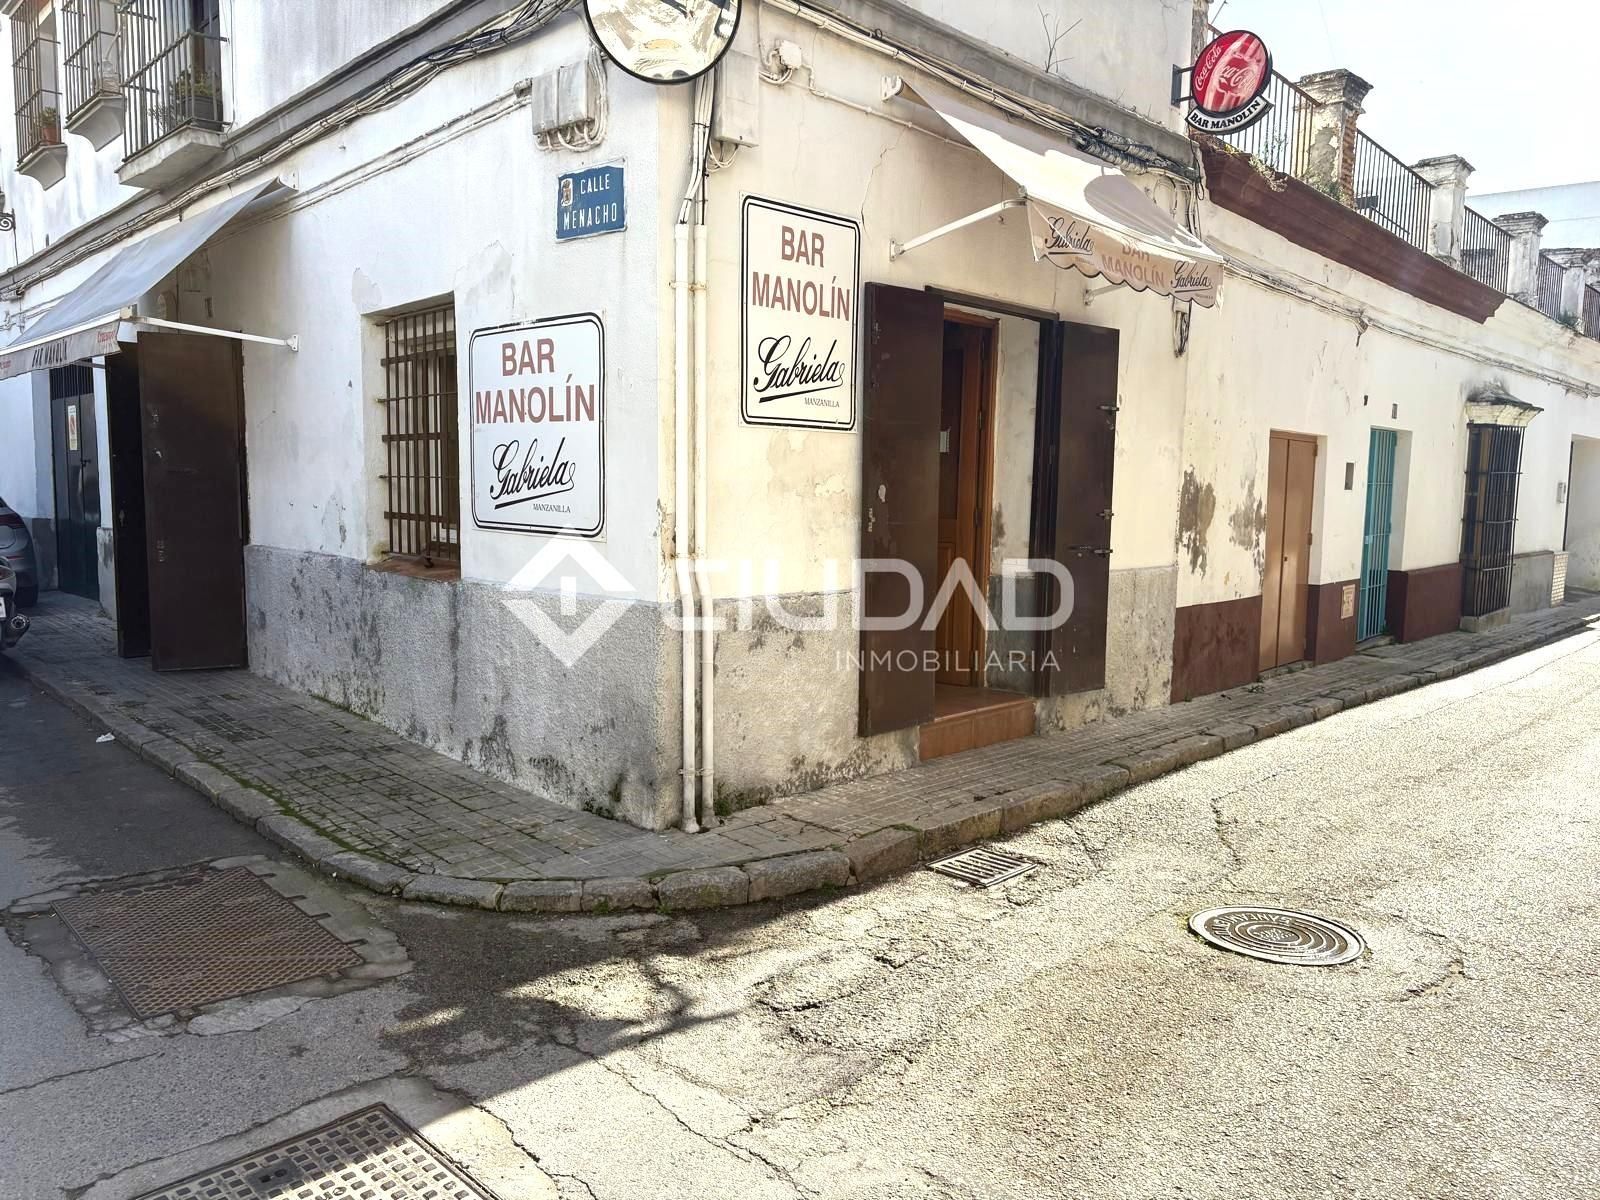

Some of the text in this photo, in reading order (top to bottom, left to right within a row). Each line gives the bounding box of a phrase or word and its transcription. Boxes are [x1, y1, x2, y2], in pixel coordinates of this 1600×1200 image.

[1189, 99, 1261, 129] BAR MANOLIN
[580, 173, 610, 195] CALLE
[563, 202, 617, 231] MENACHO
[1045, 216, 1094, 252] Gabriela
[781, 225, 825, 268] BAR
[1101, 254, 1165, 289] MANOLÍN
[1170, 260, 1212, 289] Gabriela
[752, 271, 850, 321] MANOLÍN
[502, 338, 555, 377] BAR
[753, 335, 845, 393] Gabriela
[475, 373, 595, 425] MANOLÍN
[804, 396, 840, 408] MANZANILLA
[490, 437, 576, 500] Gabriela
[532, 503, 571, 514] MANZANILLA
